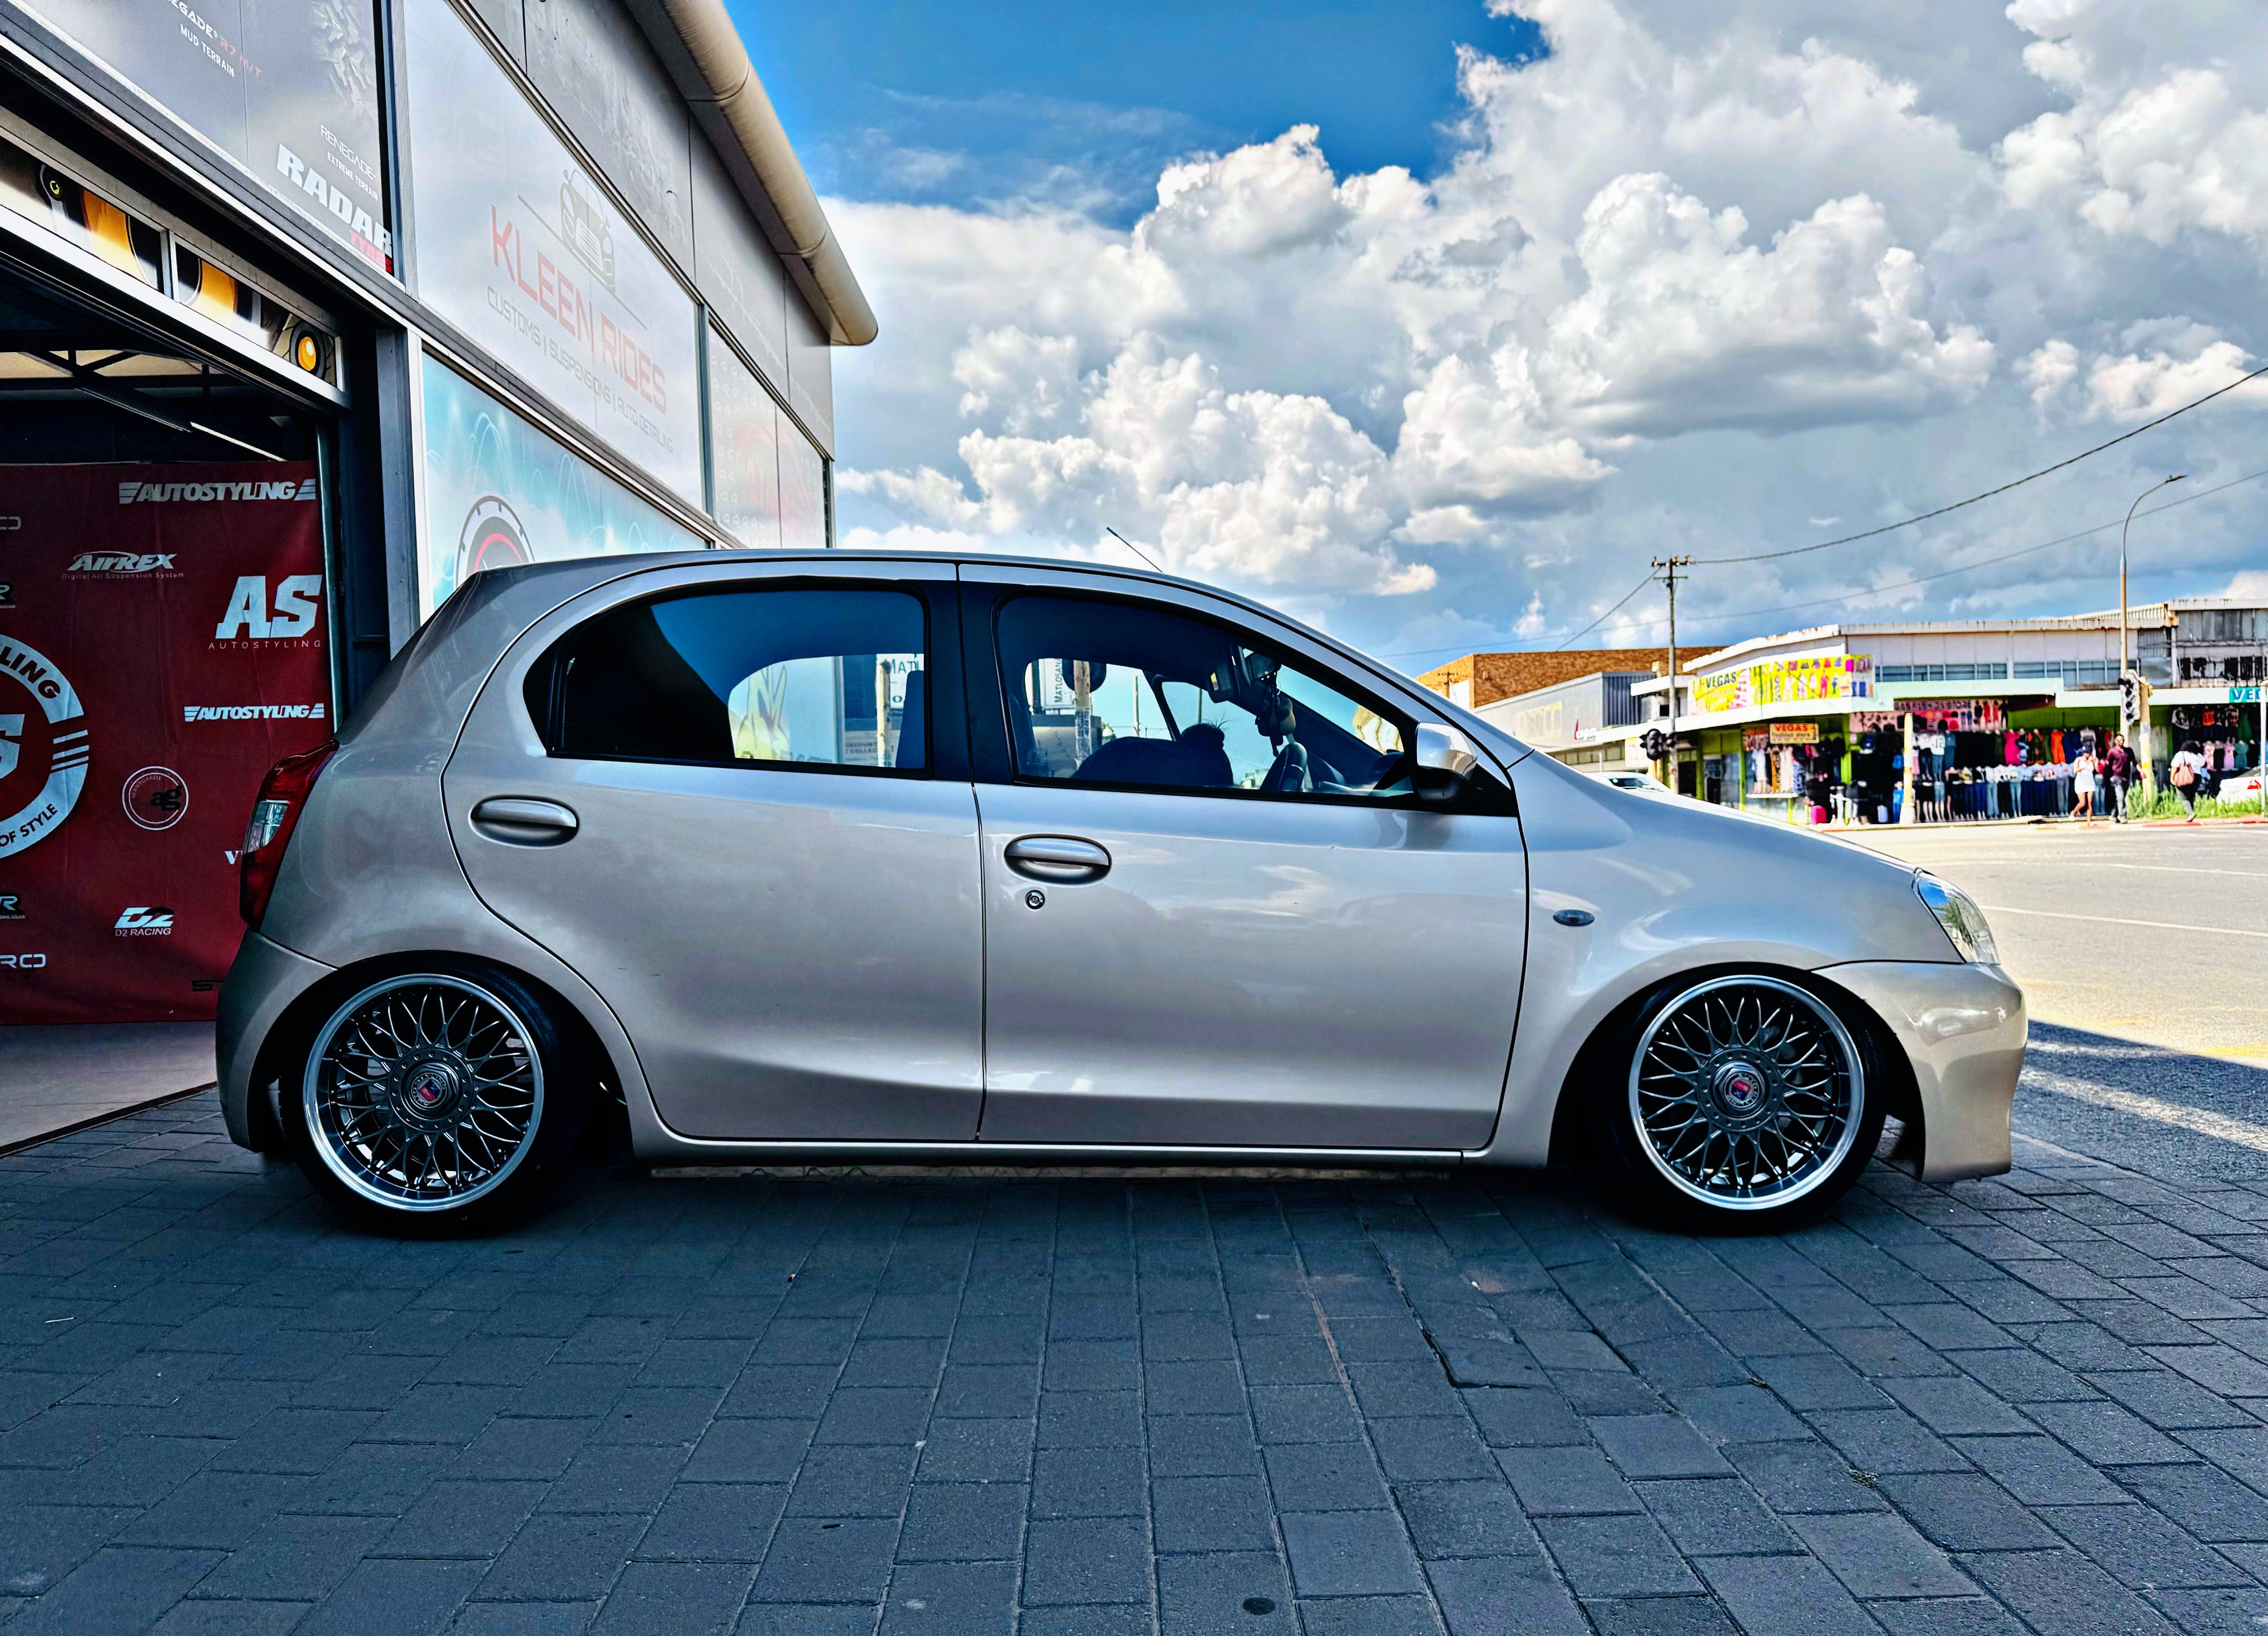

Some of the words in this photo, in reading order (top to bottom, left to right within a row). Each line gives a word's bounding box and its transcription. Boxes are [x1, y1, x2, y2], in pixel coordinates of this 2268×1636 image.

[167, 0, 214, 39] EGADE
[180, 23, 199, 47] MUD
[201, 41, 235, 77] TERRAIN
[320, 124, 377, 180] RENEGADE
[327, 151, 354, 181] EXTREME
[355, 175, 379, 201] TERRAIN
[277, 143, 393, 259] RADAR
[491, 204, 595, 353] KLEEN
[601, 311, 667, 415] RIDES
[487, 285, 541, 346] CUSTOMS
[549, 338, 611, 405] SUSPENSIONS
[617, 395, 638, 427] AUTO
[639, 413, 674, 454] DETAILING
[136, 481, 296, 502] AUTOSTYLING
[215, 574, 323, 639] AS
[208, 639, 321, 650] AUTOSTYLING
[1706, 671, 1736, 688] VEGAS
[2232, 688, 2260, 702] VE
[196, 705, 310, 721] AUTOSTYLING
[1774, 723, 1809, 732] VEGAS
[0, 831, 17, 847] OF
[20, 803, 58, 838] STYLE
[115, 929, 128, 937] D2
[130, 928, 171, 936] RACING
